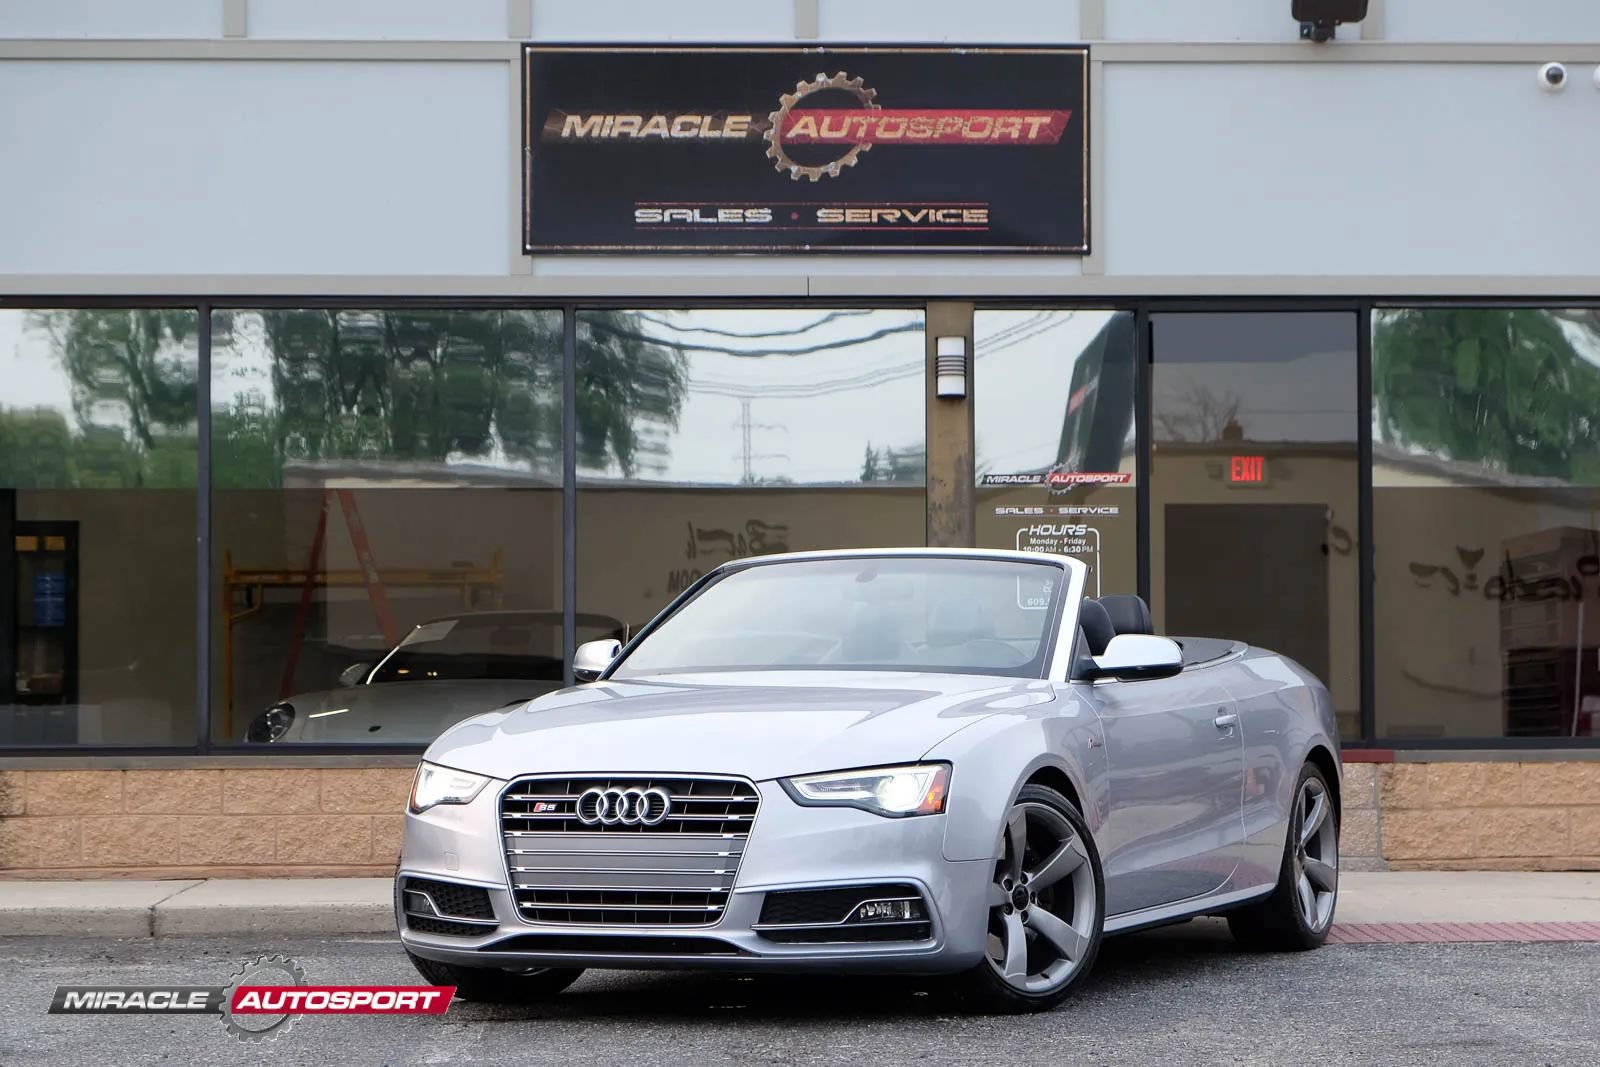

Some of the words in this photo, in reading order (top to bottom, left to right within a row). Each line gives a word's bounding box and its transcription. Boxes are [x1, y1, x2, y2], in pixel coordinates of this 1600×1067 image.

[560, 114, 752, 139] MIRACLE
[786, 115, 1052, 139] AUTOSPORT
[634, 208, 773, 223] SALES
[816, 208, 989, 223] SERVICE
[1232, 456, 1264, 481] EXIT
[986, 475, 1041, 483] MIRACLE
[1050, 474, 1127, 483] AUTOSPORT
[995, 507, 1044, 515] SALES
[1058, 507, 1119, 515] SERVICE
[1029, 525, 1087, 536] HOURS
[1029, 538, 1058, 546] Monday
[1063, 538, 1086, 546] Friday
